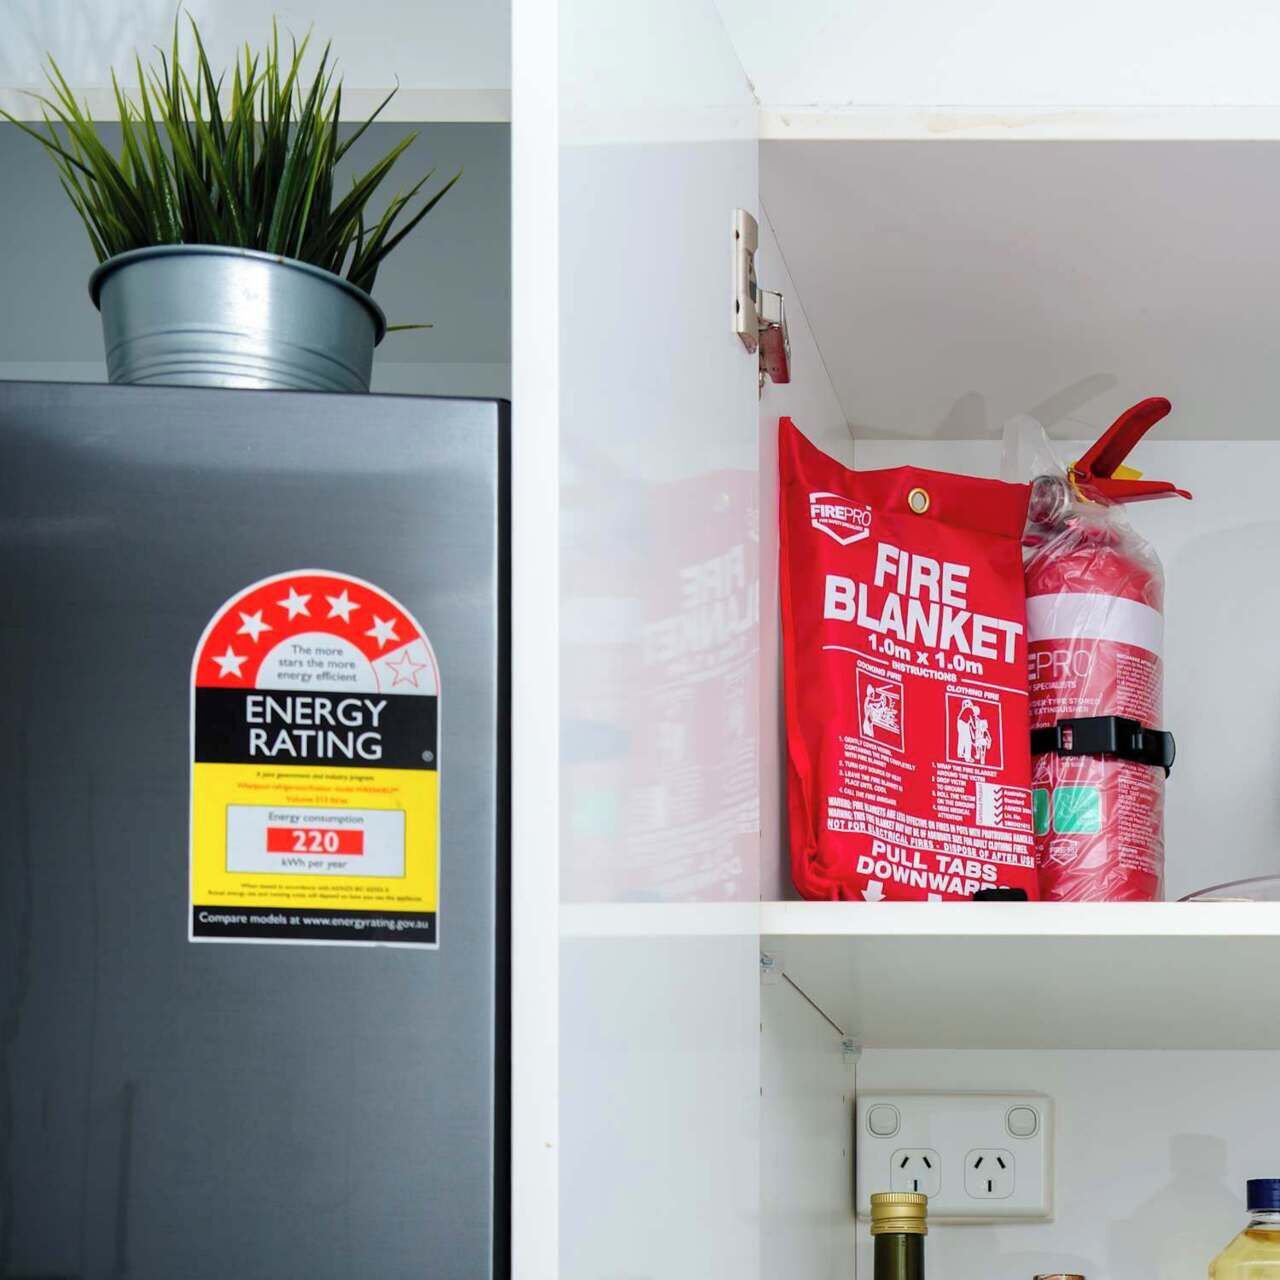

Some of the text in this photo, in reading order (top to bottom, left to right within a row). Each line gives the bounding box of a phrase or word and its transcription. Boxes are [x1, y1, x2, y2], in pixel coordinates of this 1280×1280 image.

[810, 504, 872, 526] FIREPRO
[874, 542, 970, 608] FIRE
[823, 574, 1023, 664] BLANKET
[291, 644, 343, 656] The more
[869, 634, 984, 675] 1.0m x 1.0m
[278, 658, 356, 669] stars the more
[857, 659, 902, 682] COOKING FIRE
[892, 661, 957, 683] INSTRUCTIONS
[277, 671, 357, 683] energy efficient
[946, 684, 1000, 701] CLOTHING FIRE
[246, 695, 387, 727] ENERGY
[249, 728, 383, 760] RATING
[268, 812, 364, 825] Energy consumption
[292, 830, 340, 852] 220
[828, 819, 845, 830] NOT
[847, 819, 865, 831] FOR
[867, 824, 909, 844] ELECTRICAL
[911, 837, 934, 849] FIRES
[944, 843, 977, 858] DISPOSE
[979, 849, 990, 859] OF
[992, 852, 1018, 864] AFTER
[281, 857, 347, 870] kWh per year
[871, 840, 998, 882] PULL TABS
[199, 911, 429, 931] Compare models at www.energyrating.gov.au
